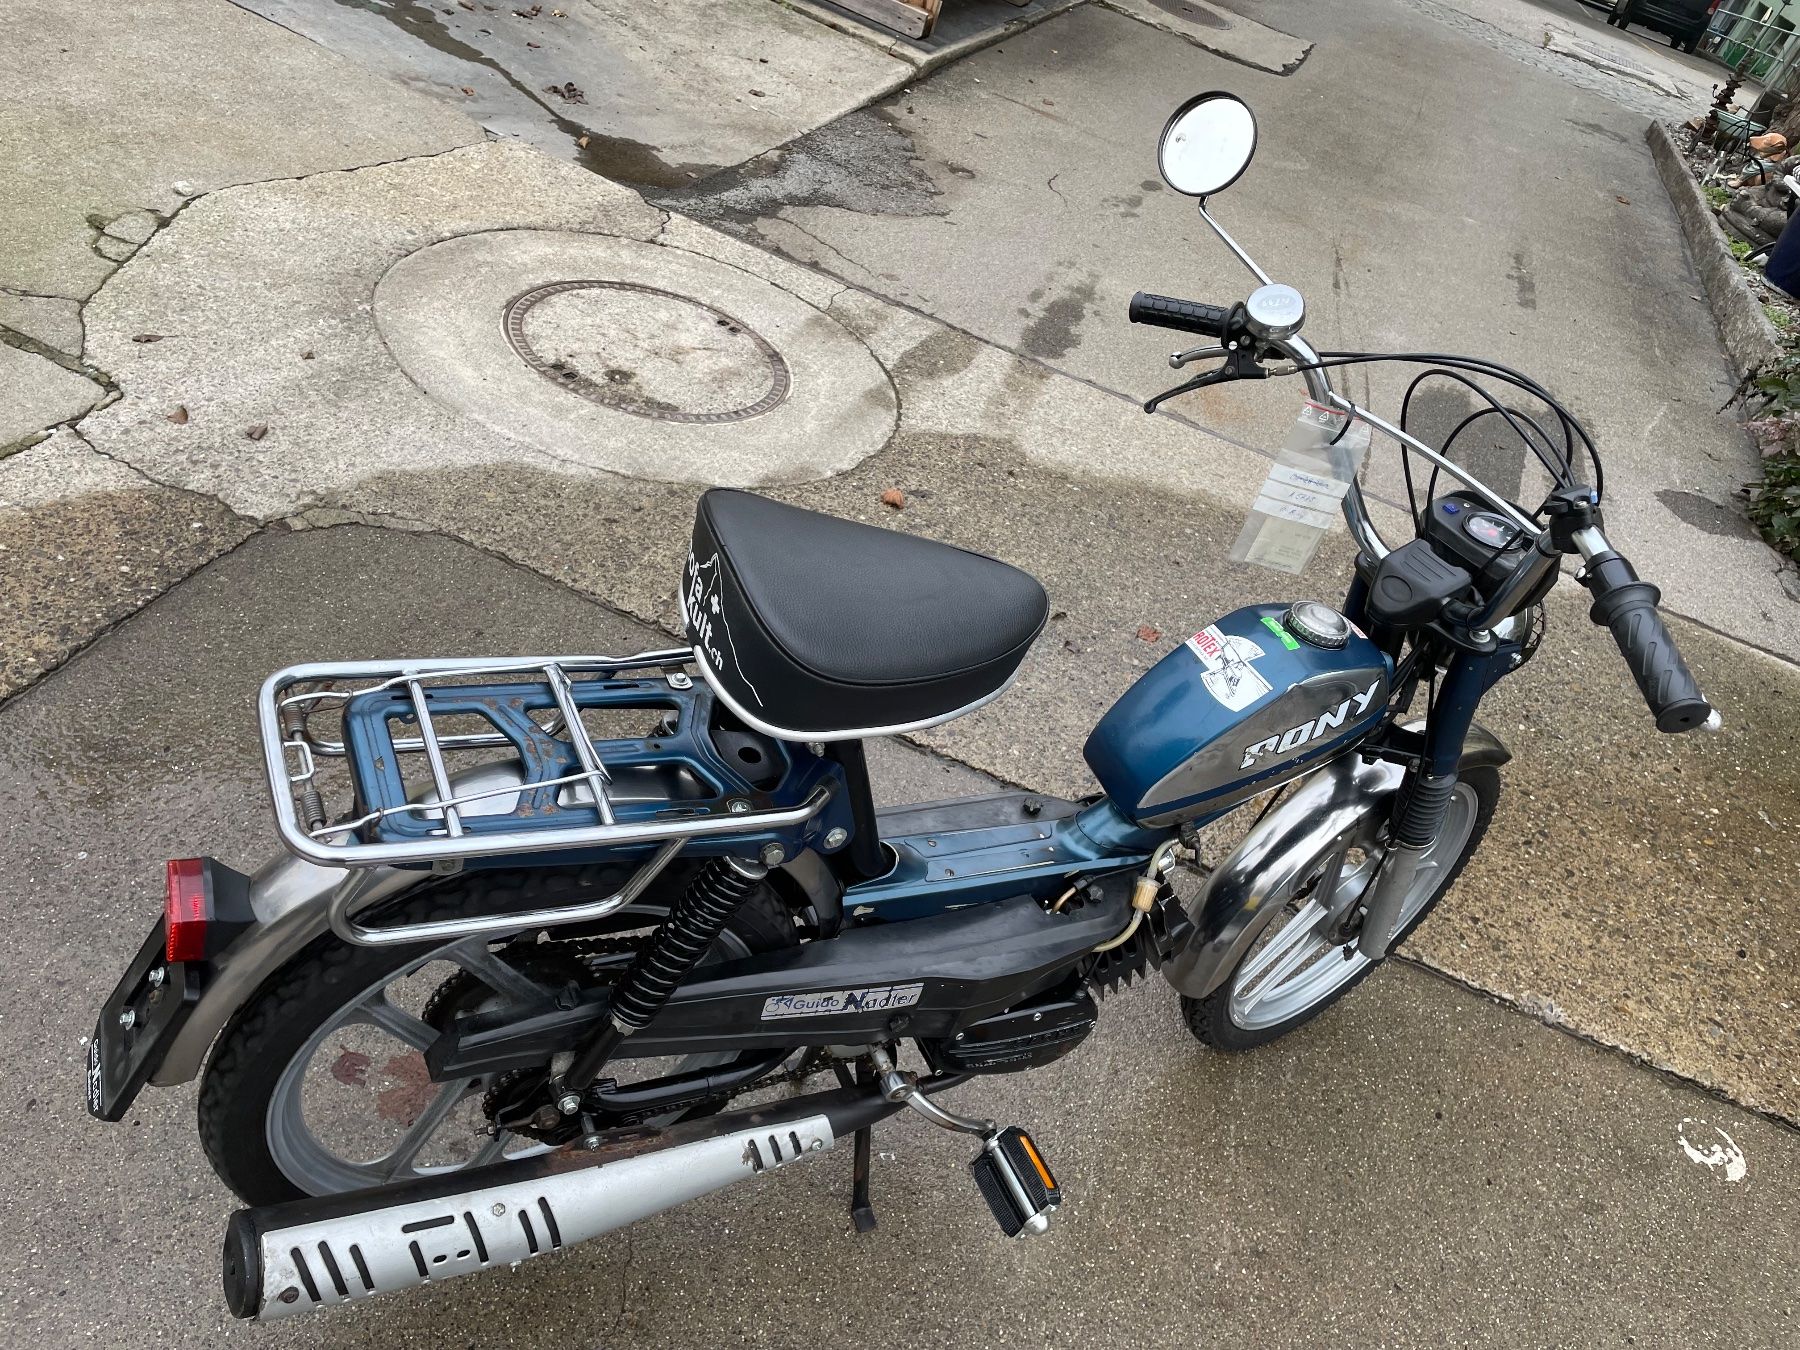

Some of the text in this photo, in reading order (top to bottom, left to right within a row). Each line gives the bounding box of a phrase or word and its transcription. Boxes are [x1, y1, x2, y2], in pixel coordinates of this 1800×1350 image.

[688, 551, 703, 603] ofa
[1192, 630, 1220, 657] ROTEX
[1239, 678, 1381, 771] PONY
[842, 988, 918, 1011] Nadler
